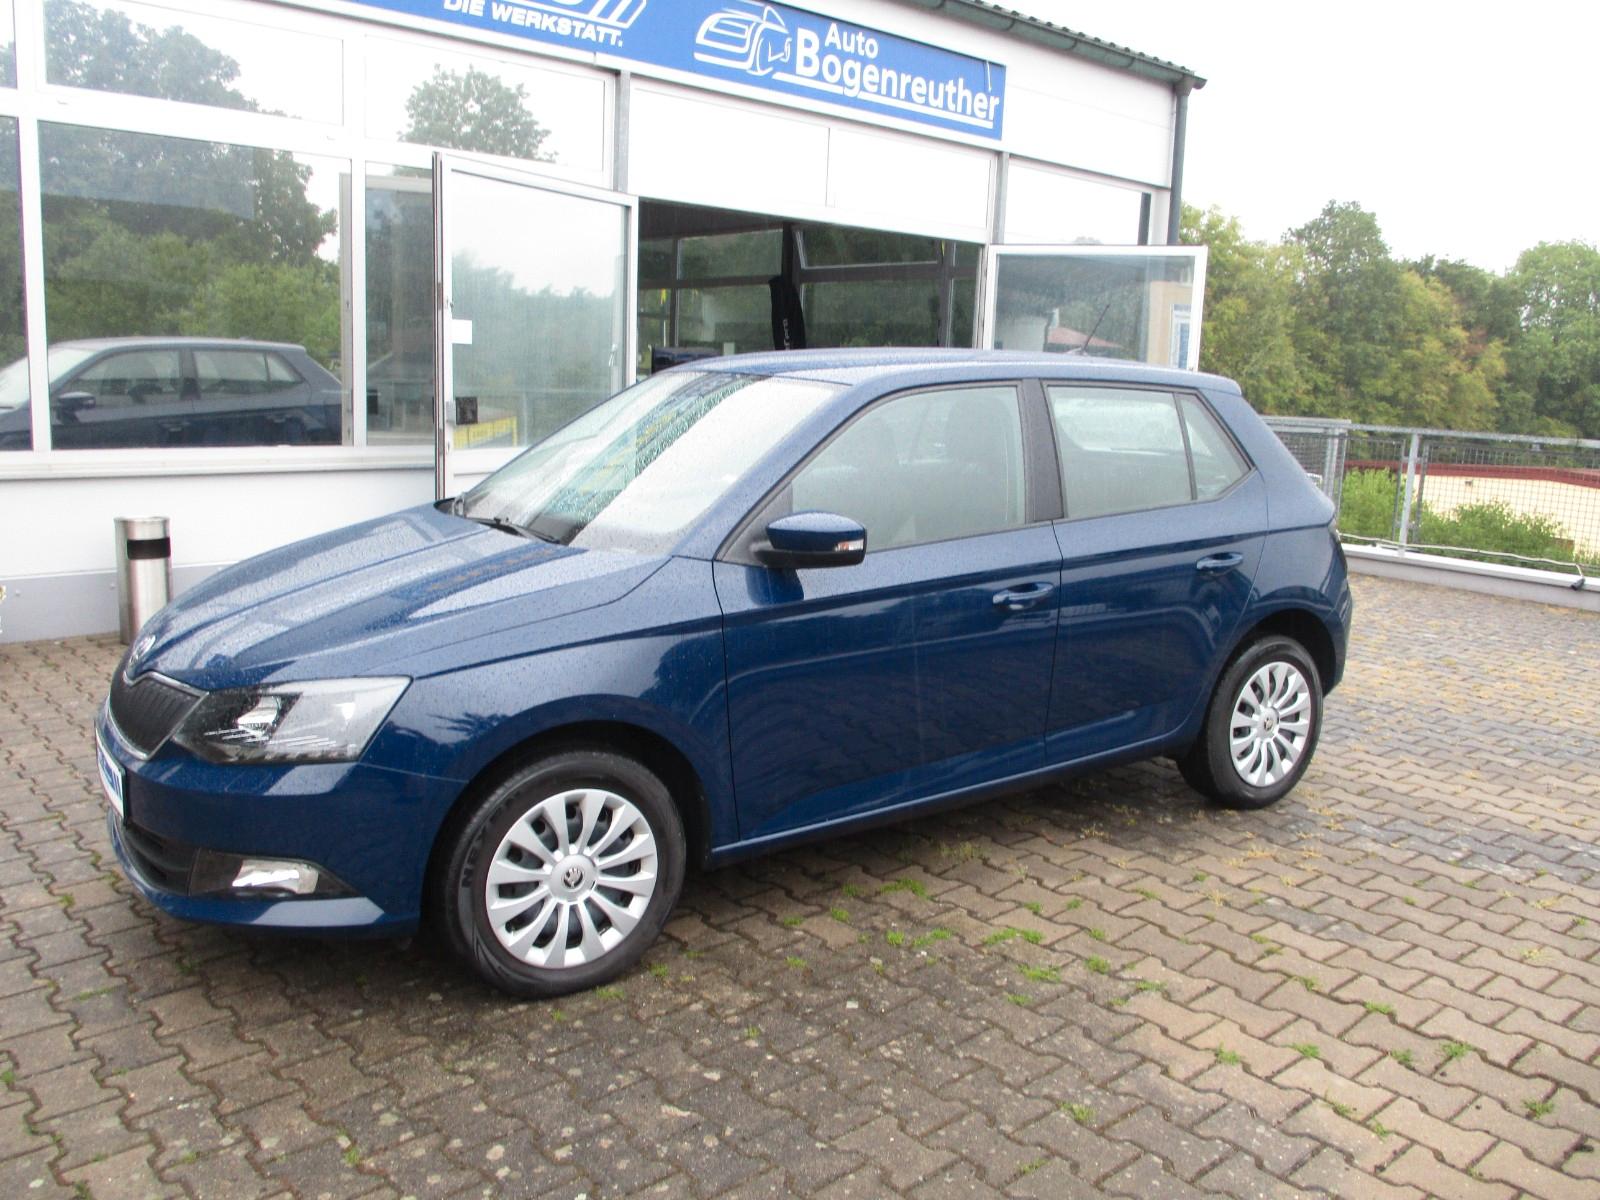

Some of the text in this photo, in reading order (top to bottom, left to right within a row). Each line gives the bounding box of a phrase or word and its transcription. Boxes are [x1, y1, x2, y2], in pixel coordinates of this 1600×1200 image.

[443, 0, 484, 17] DIE
[491, 2, 623, 48] WERKSTATT.
[824, 22, 879, 59] Auto
[795, 27, 999, 121] Bogenreuther
